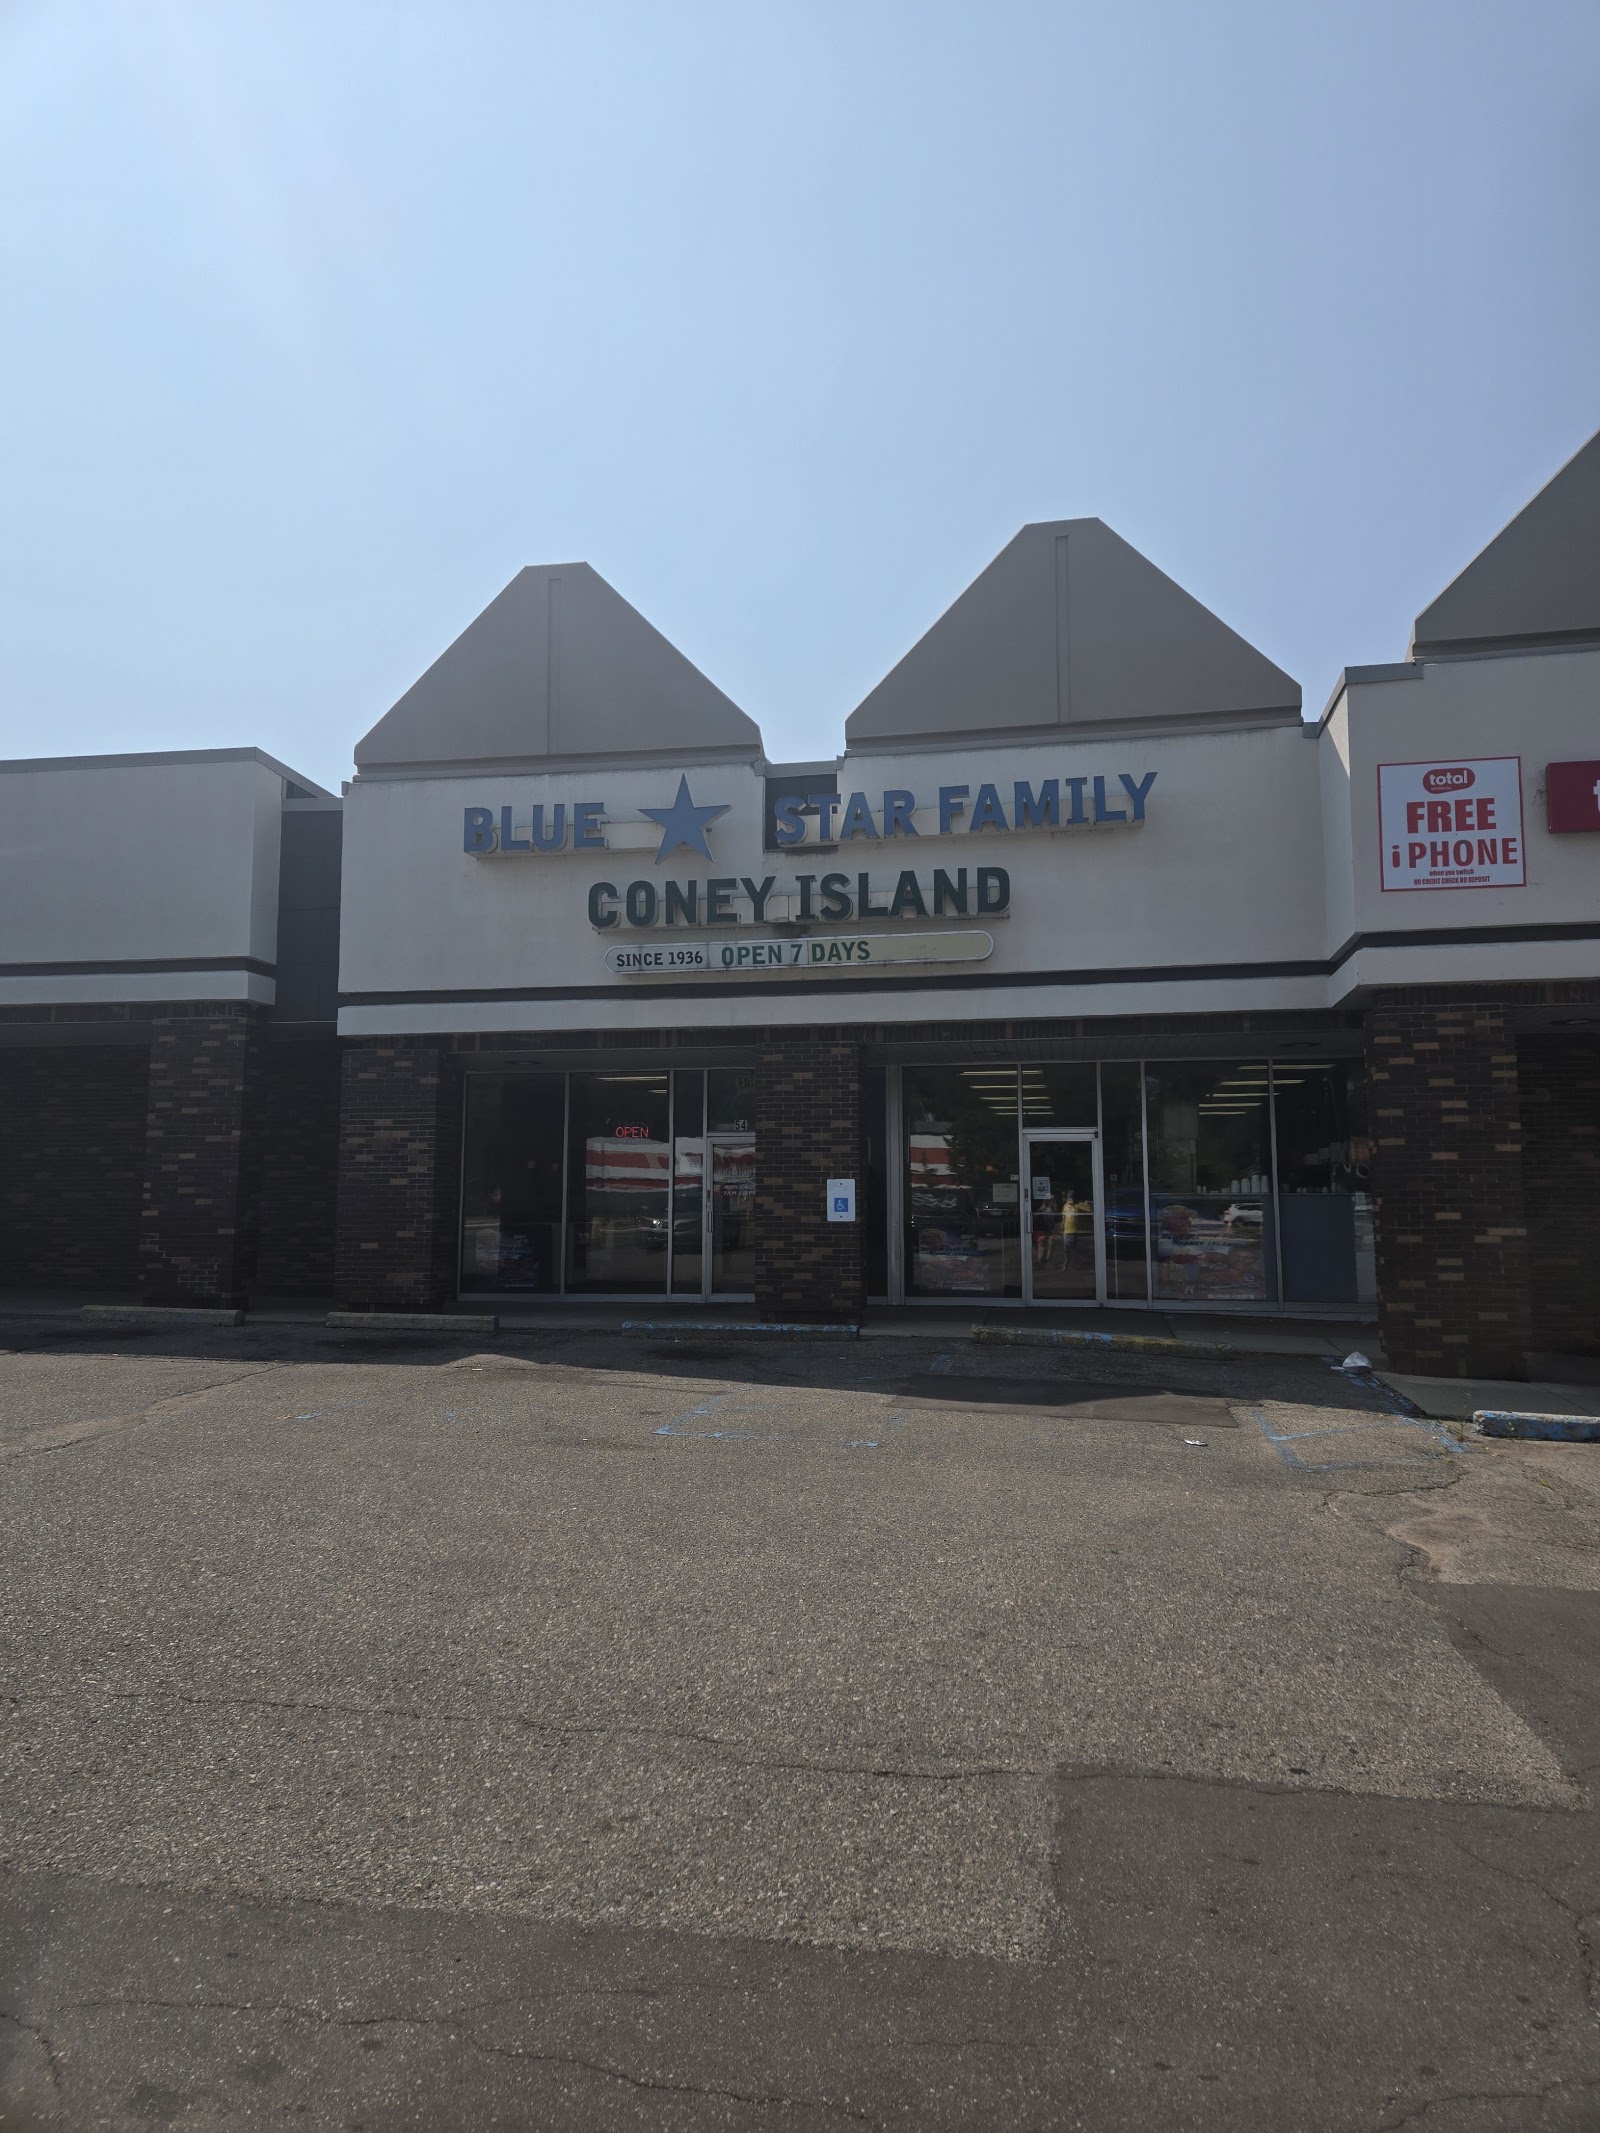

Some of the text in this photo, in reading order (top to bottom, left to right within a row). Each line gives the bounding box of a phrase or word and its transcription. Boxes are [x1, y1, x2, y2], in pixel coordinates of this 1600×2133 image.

[1429, 769, 1468, 786] total
[463, 772, 1158, 852] BLUE STAR FAMILY
[1406, 797, 1497, 834] FREE
[1422, 877, 1440, 885] CREDIT
[1468, 875, 1491, 883] DEPOSIT
[588, 866, 1011, 929] CONEY ISLAND
[616, 940, 870, 967] SINCE 1936 OPEN 7 DAYS
[615, 1126, 649, 1138] OPEN
[735, 1121, 747, 1130] 54
